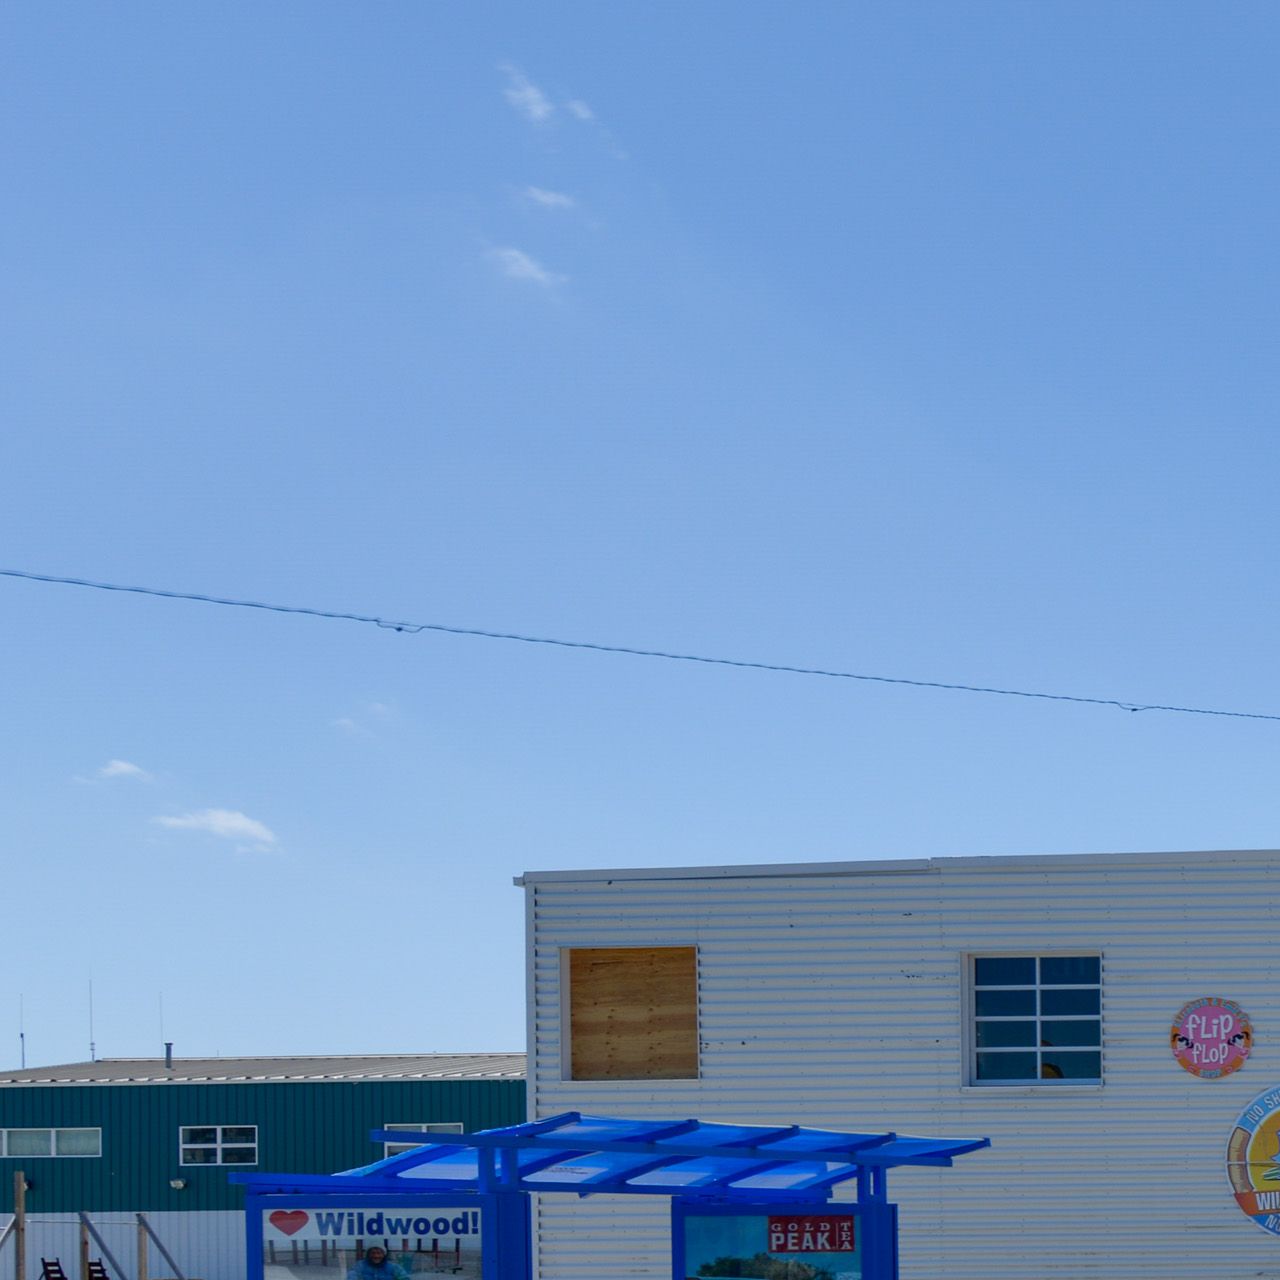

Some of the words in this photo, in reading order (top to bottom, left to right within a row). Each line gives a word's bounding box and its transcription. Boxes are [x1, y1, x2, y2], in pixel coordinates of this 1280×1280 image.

[1246, 1104, 1264, 1124] NO
[315, 1211, 479, 1236] Wildwood!
[771, 1222, 831, 1231] GOLD
[771, 1232, 831, 1250] PEAK
[840, 1222, 852, 1250] TEA
